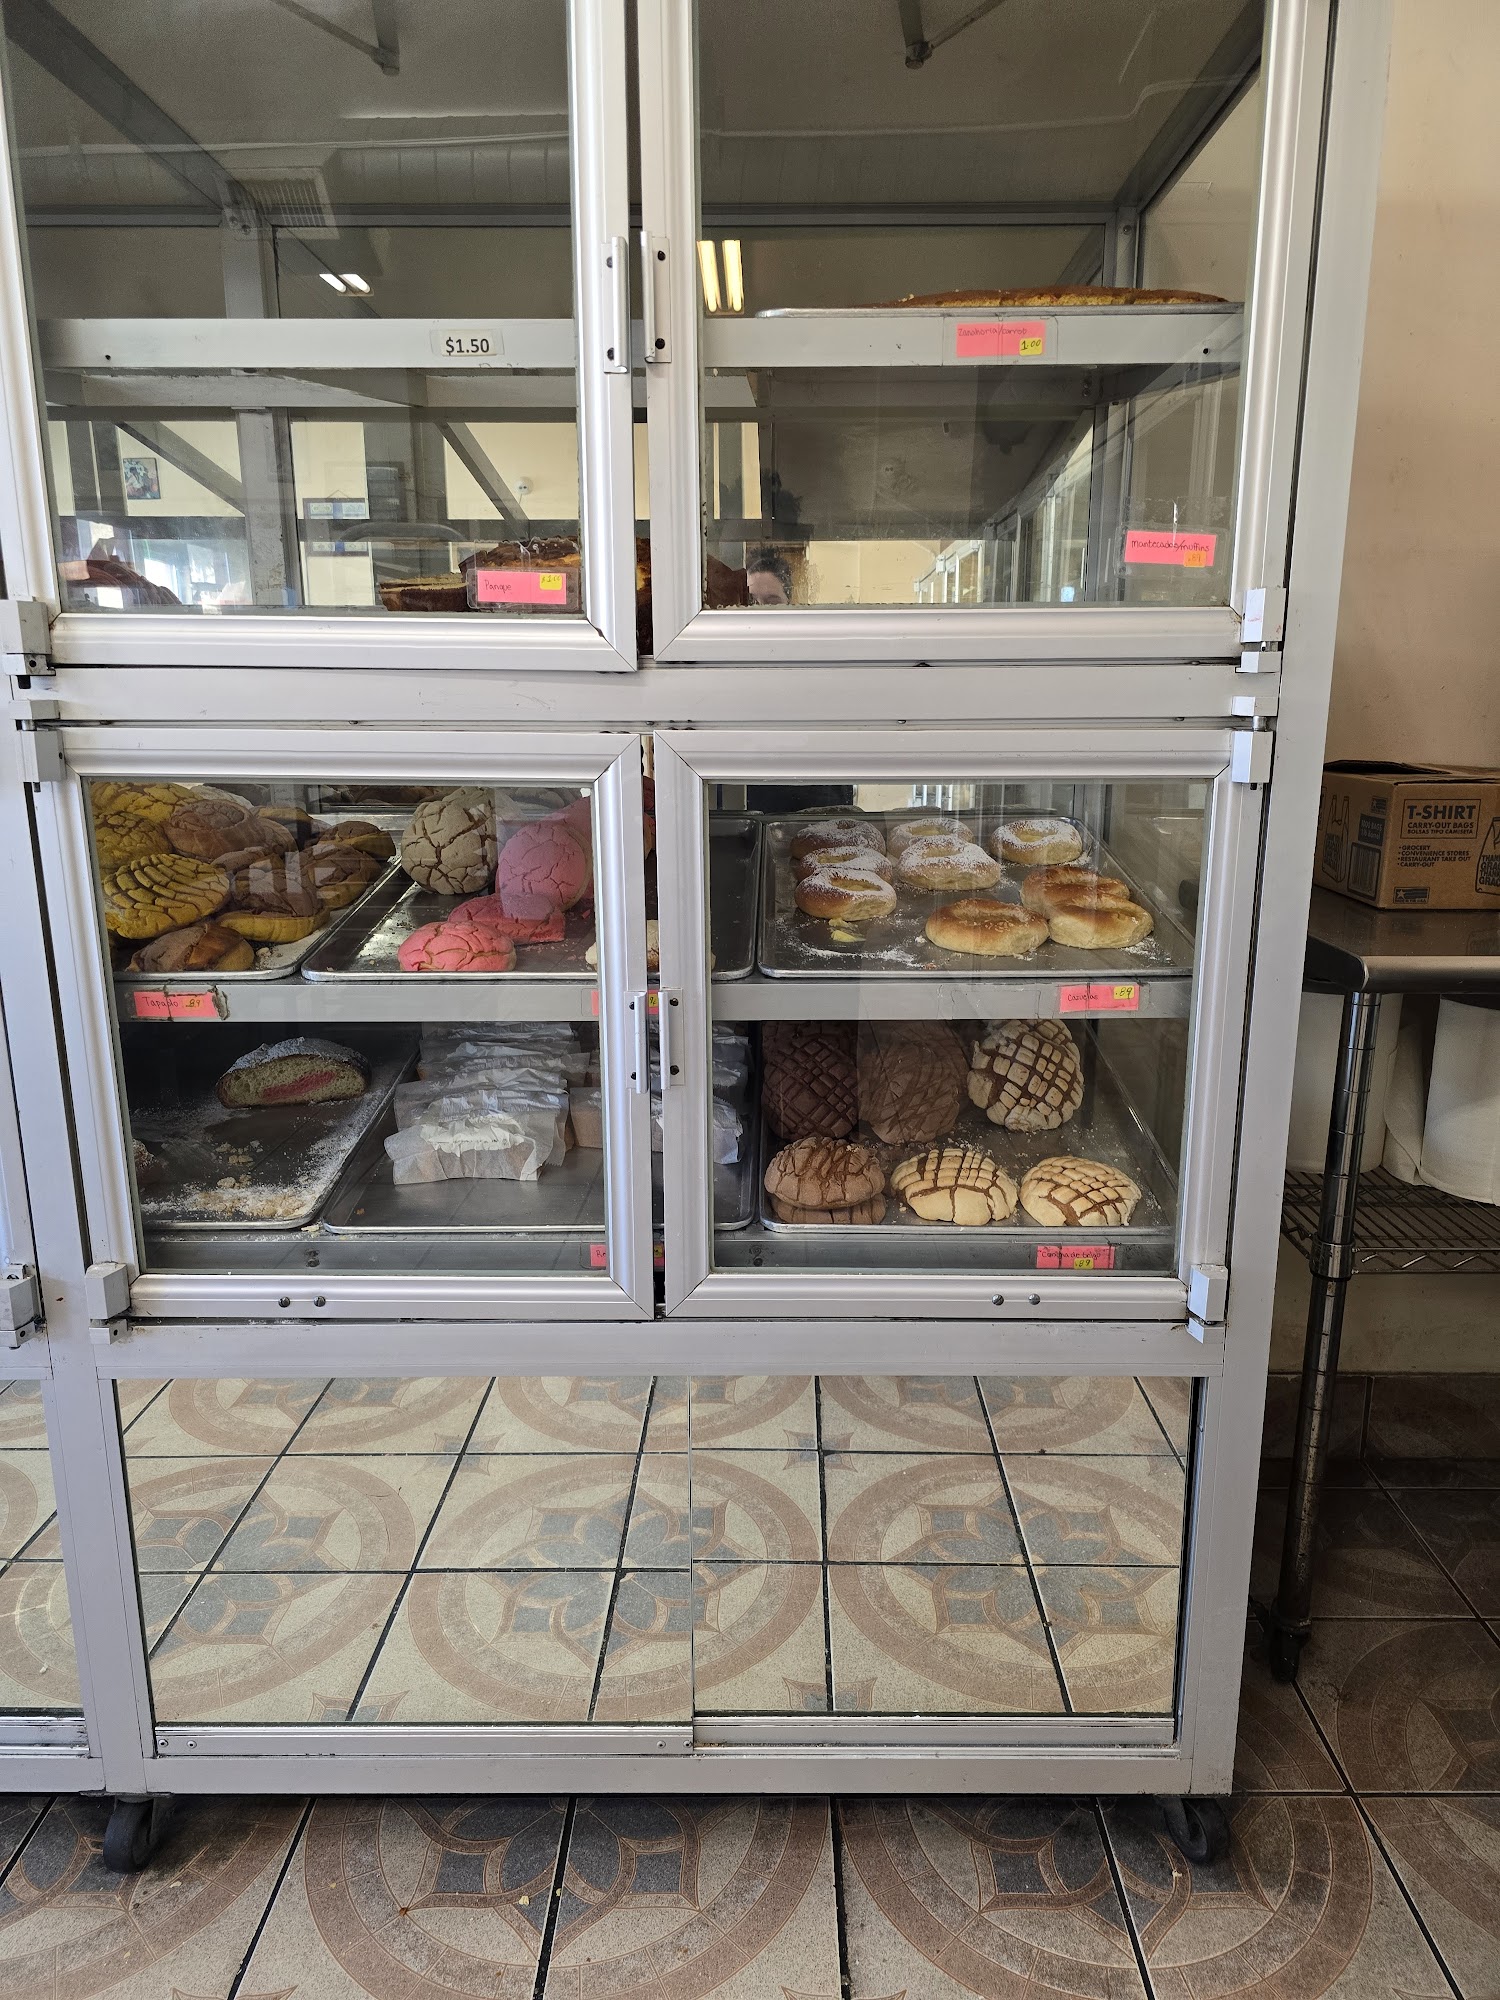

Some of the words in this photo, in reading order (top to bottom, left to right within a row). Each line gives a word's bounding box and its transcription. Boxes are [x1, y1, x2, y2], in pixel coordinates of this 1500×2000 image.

[445, 336, 490, 356] $1.50
[1020, 339, 1042, 351] 1.00
[1407, 805, 1476, 819] T-SHIRT
[1407, 821, 1452, 829] CARRY-OUT
[1452, 821, 1474, 829] BAGS
[1115, 986, 1133, 999] .89
[141, 996, 179, 1009] Tapado
[1075, 1259, 1091, 1268] .89
